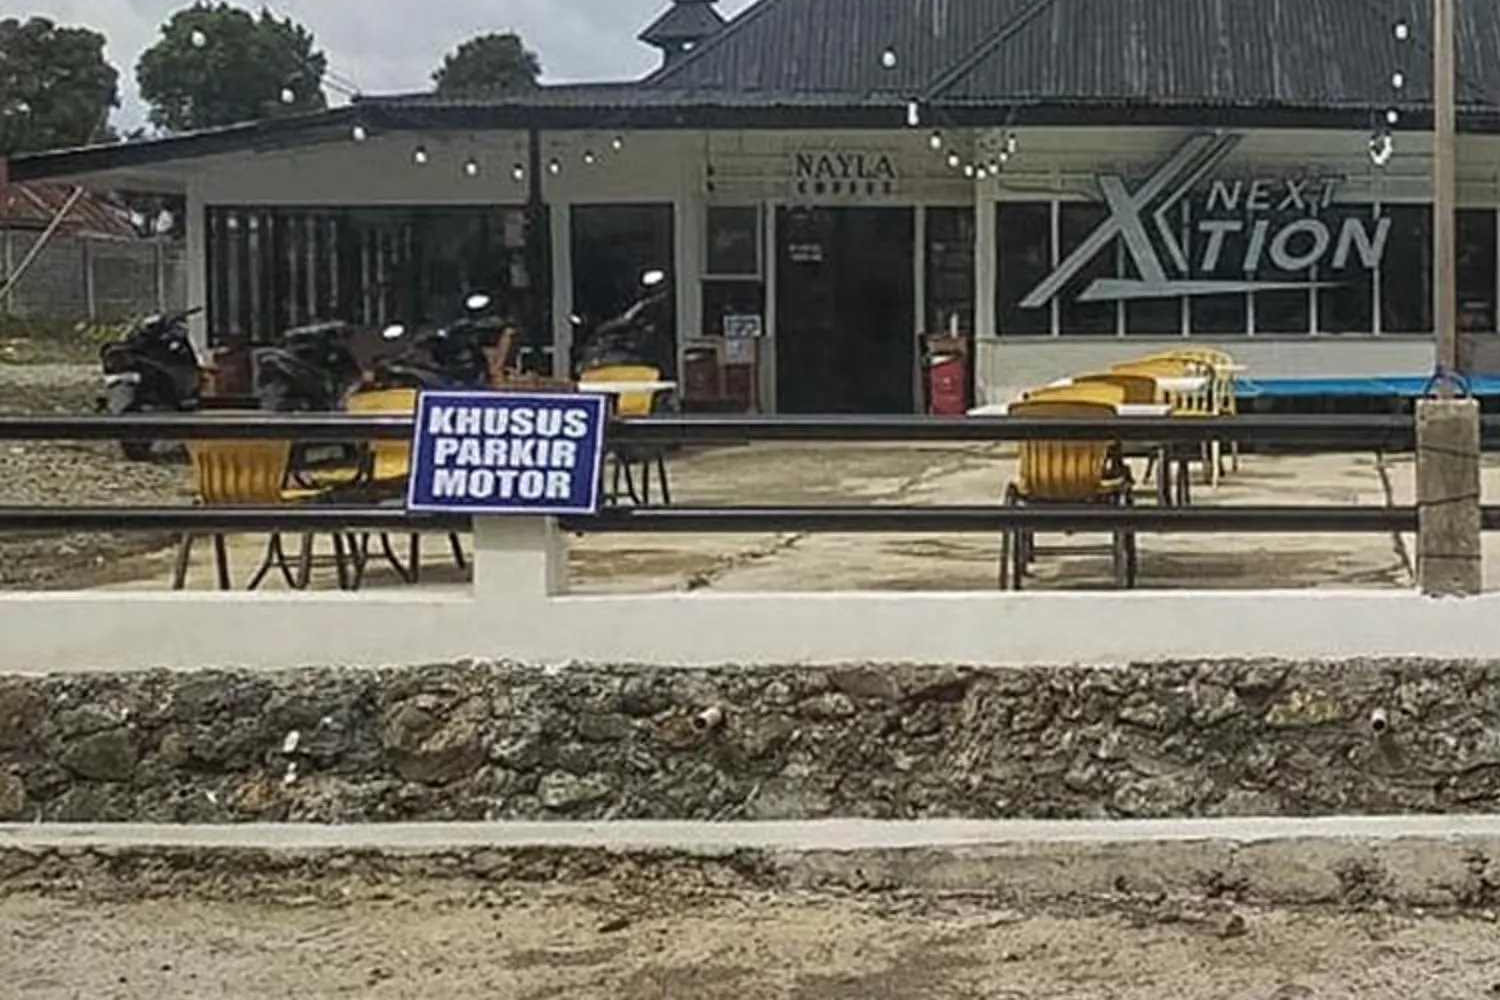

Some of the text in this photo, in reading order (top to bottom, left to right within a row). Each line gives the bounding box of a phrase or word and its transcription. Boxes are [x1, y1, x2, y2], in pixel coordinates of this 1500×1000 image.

[795, 153, 897, 178] NAYLA
[1206, 177, 1346, 211] NEXT
[428, 406, 588, 438] KHUSUS
[434, 437, 577, 467] PARKIR
[432, 468, 571, 499] MOTOR
